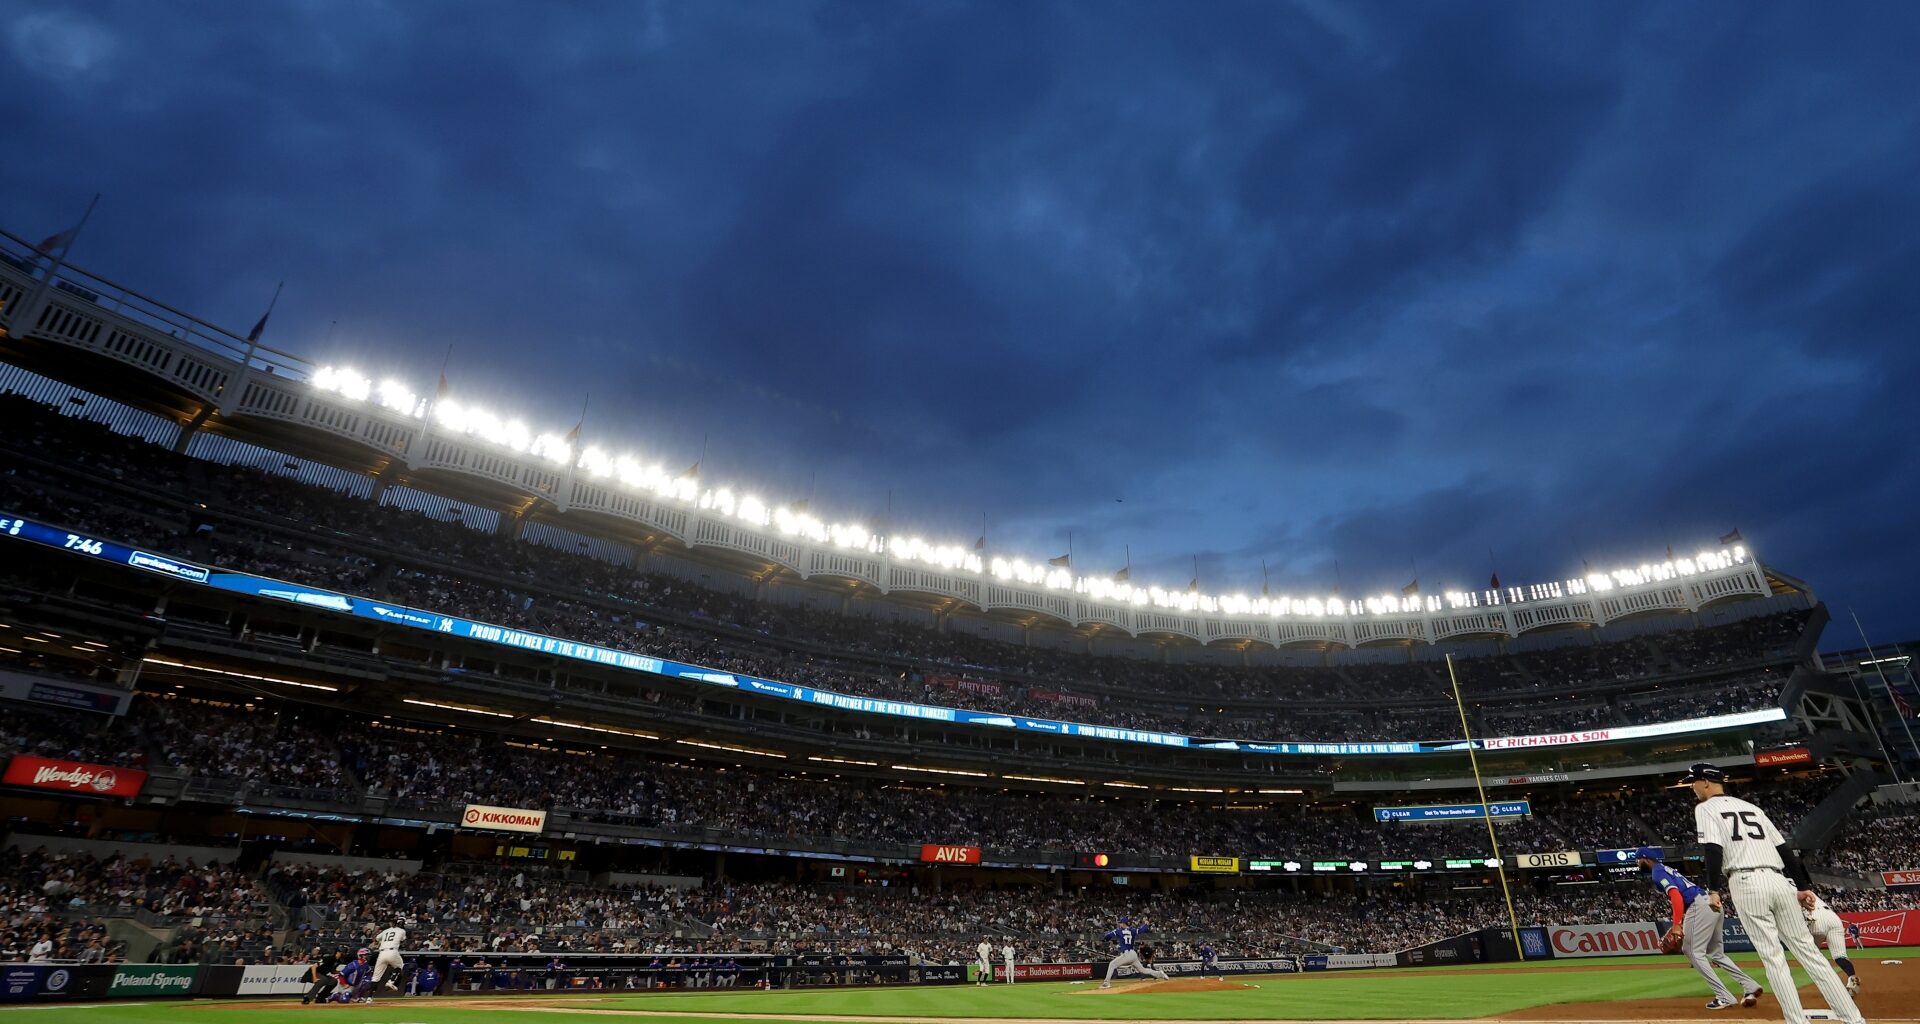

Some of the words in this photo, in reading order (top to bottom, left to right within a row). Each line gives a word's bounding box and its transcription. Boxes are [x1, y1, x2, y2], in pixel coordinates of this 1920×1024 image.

[65, 534, 103, 555] 7:46
[134, 554, 204, 578] yankees.com
[469, 623, 501, 641] PROUD
[502, 630, 542, 649] PARTNER
[544, 638, 556, 652] OF
[557, 640, 573, 656] THE
[575, 643, 596, 660] NEW
[596, 646, 617, 664] YORK
[619, 650, 654, 671] YANKEES
[958, 680, 980, 691] PARTY
[981, 684, 1000, 695] DECK
[813, 691, 833, 705] PROUD
[834, 694, 862, 708] PARTNER
[864, 699, 873, 711] OF
[875, 700, 886, 713] THE
[887, 702, 902, 714] NEW
[903, 704, 919, 717] YORK
[921, 707, 948, 720] YANKEES
[1058, 694, 1078, 705] PARTY
[1078, 725, 1095, 736] PROUD
[1096, 727, 1118, 739] PARTNER
[1119, 730, 1126, 740] OF
[1127, 731, 1136, 741] THE
[1137, 732, 1148, 742] NEW
[1149, 733, 1161, 744] YORK
[1162, 735, 1184, 746] YANKEES
[1487, 740, 1503, 748] PC
[1507, 734, 1568, 747] RICHARD
[1570, 734, 1579, 742] &
[1582, 731, 1609, 741] SON
[1298, 744, 1315, 753] PROUD
[1316, 744, 1339, 753] PARTNER
[1340, 744, 1347, 753] OF
[1349, 744, 1359, 753] THE
[1360, 744, 1372, 753] NEW
[1373, 744, 1388, 753] YORK
[1389, 743, 1414, 753] YANKEES
[1771, 752, 1809, 762] Budweiser
[33, 766, 93, 788] Wendy's
[1528, 775, 1554, 783] YANKEES
[482, 812, 541, 827] KIKKOMAN
[1720, 811, 1765, 842] 75
[934, 847, 967, 862] AVIS
[1529, 853, 1569, 866] ORIS
[384, 932, 396, 942] 12
[1523, 933, 1539, 941] NEW
[1551, 927, 1662, 954] Canon
[1029, 966, 1060, 976] Budweiser
[1062, 965, 1091, 975] Budweiser
[111, 972, 152, 989] Poland
[154, 972, 192, 989] Spring
[269, 976, 282, 984] OF
